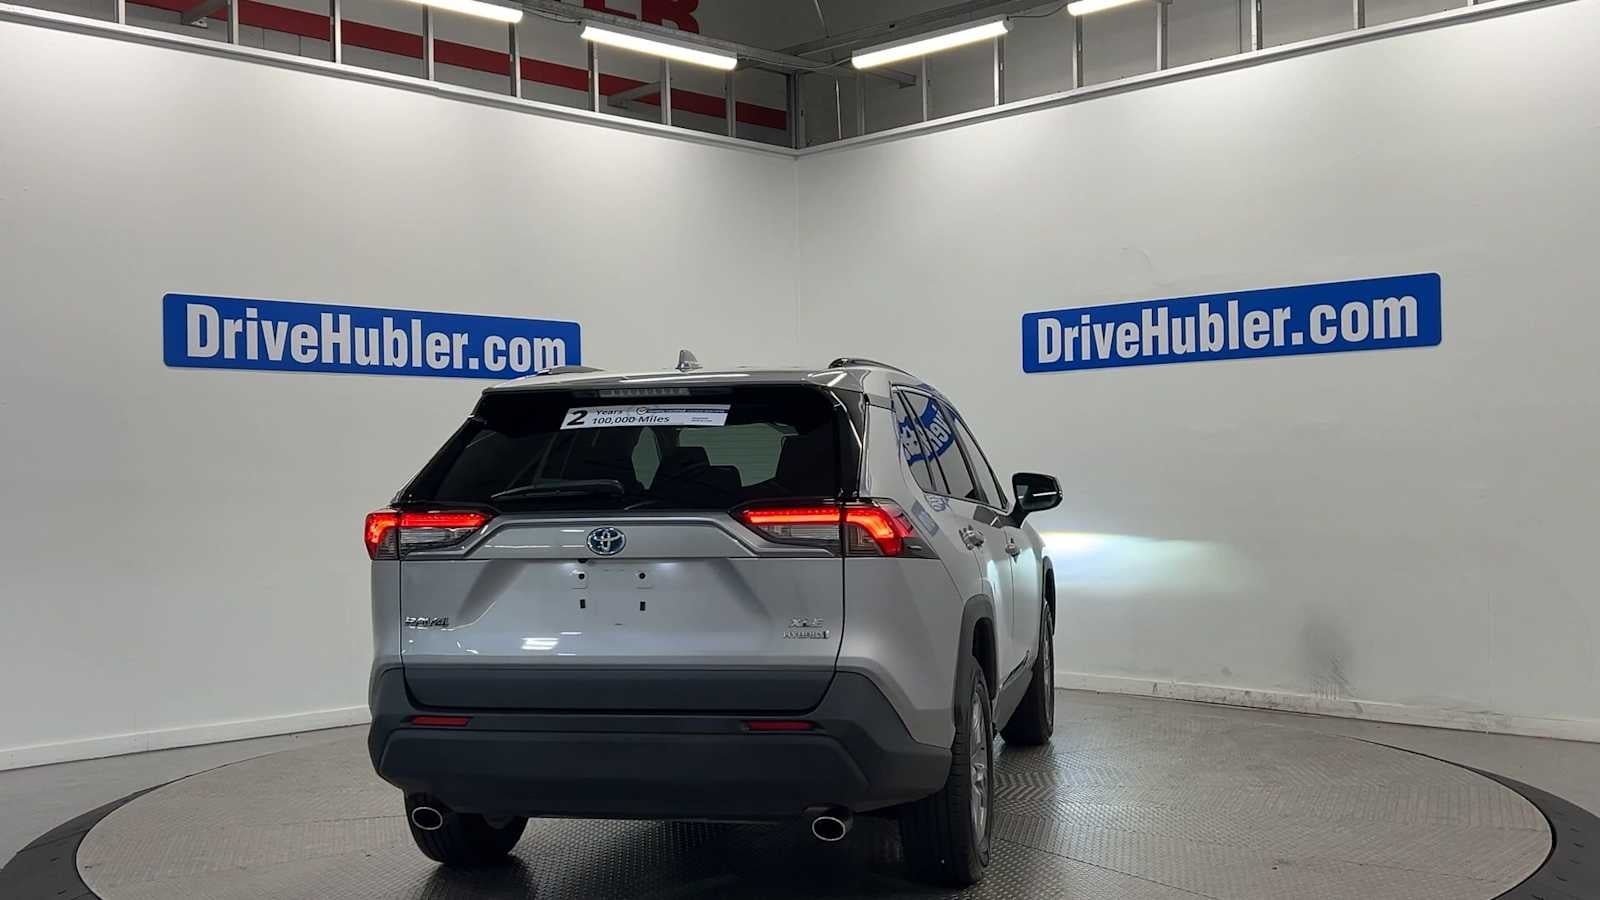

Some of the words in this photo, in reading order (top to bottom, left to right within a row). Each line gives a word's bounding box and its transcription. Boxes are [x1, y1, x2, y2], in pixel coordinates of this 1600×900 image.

[186, 303, 566, 371] DriveHubler.com
[1037, 295, 1418, 364] DriveHubler.com
[566, 410, 588, 426] 2
[595, 408, 624, 416] Years
[592, 416, 635, 424] 100,000
[638, 415, 670, 423] Miles
